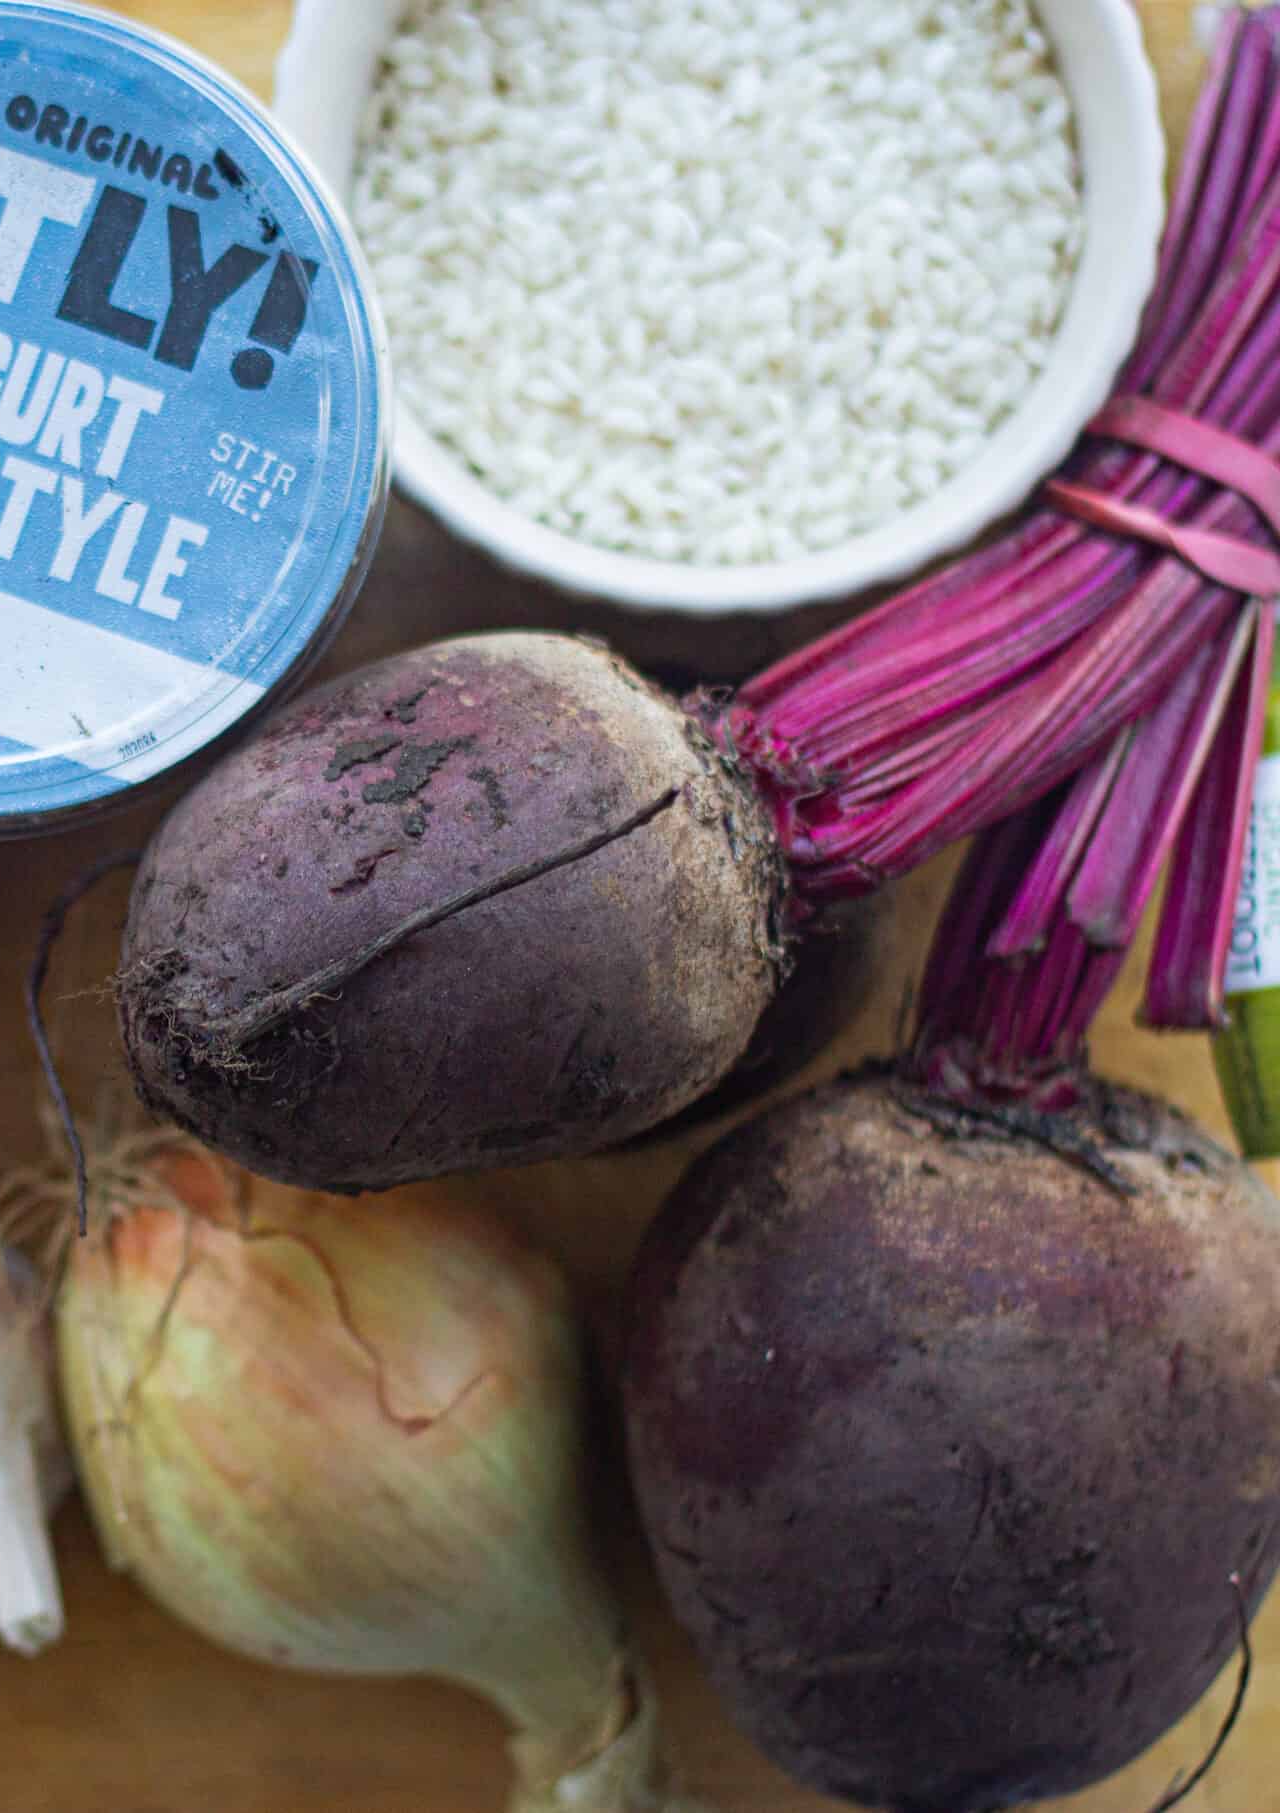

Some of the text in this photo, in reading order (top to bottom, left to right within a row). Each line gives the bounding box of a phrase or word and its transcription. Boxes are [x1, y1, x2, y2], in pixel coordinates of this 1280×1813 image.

[5, 95, 220, 200] ORIGINAL
[210, 432, 297, 495] STIR
[207, 470, 272, 522] ME!
